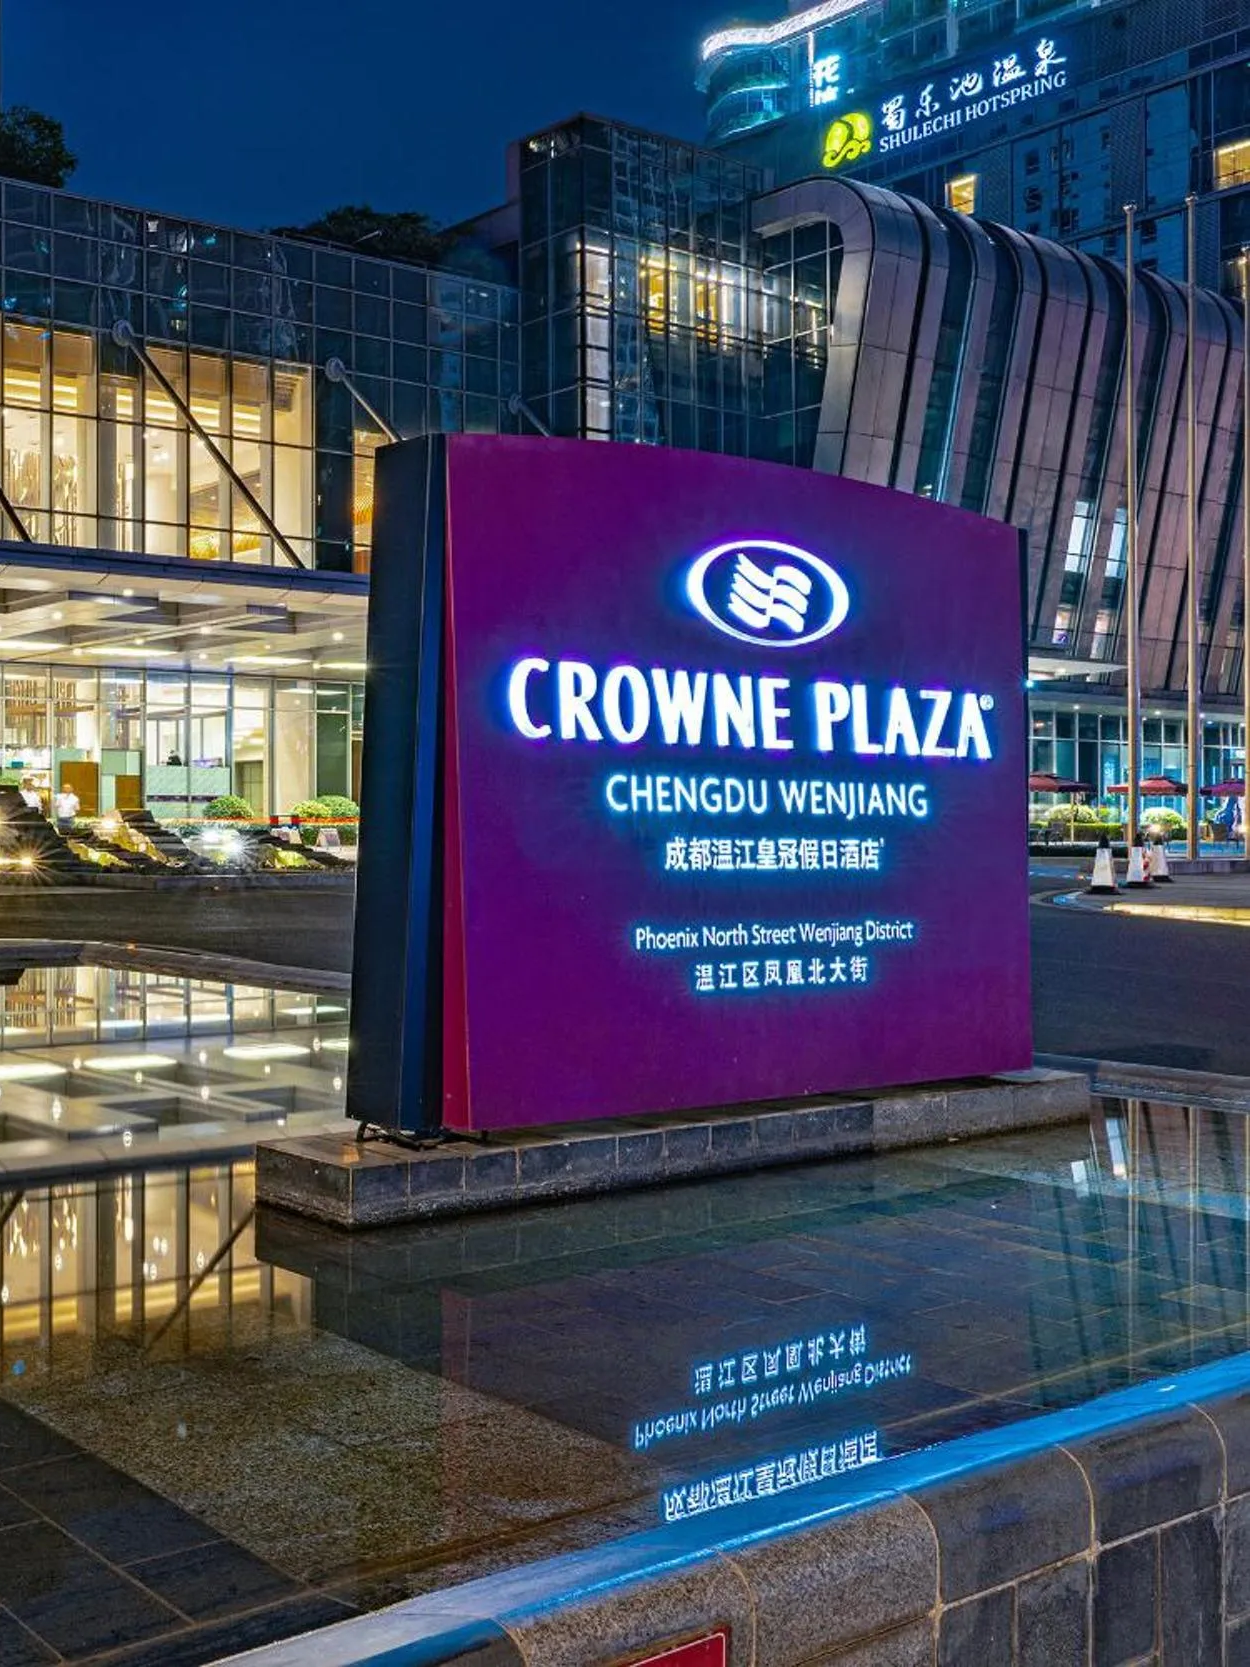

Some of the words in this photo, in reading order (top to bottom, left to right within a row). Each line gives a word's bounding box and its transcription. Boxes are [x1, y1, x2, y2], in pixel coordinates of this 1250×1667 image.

[880, 108, 961, 152] SHULECHI
[965, 71, 1067, 122] HOTSPRING
[508, 657, 794, 751] CROWNE
[606, 775, 768, 814] CHENGDU
[779, 780, 929, 819] WENJIANG
[665, 836, 880, 871] 成都温江皇冠假日酒店
[635, 926, 699, 950] Phoenix
[702, 923, 748, 946] North
[751, 924, 796, 944] Street
[799, 921, 863, 947] Wenjiang
[865, 920, 914, 940] District
[695, 956, 869, 991] 温江区凤凰北大街
